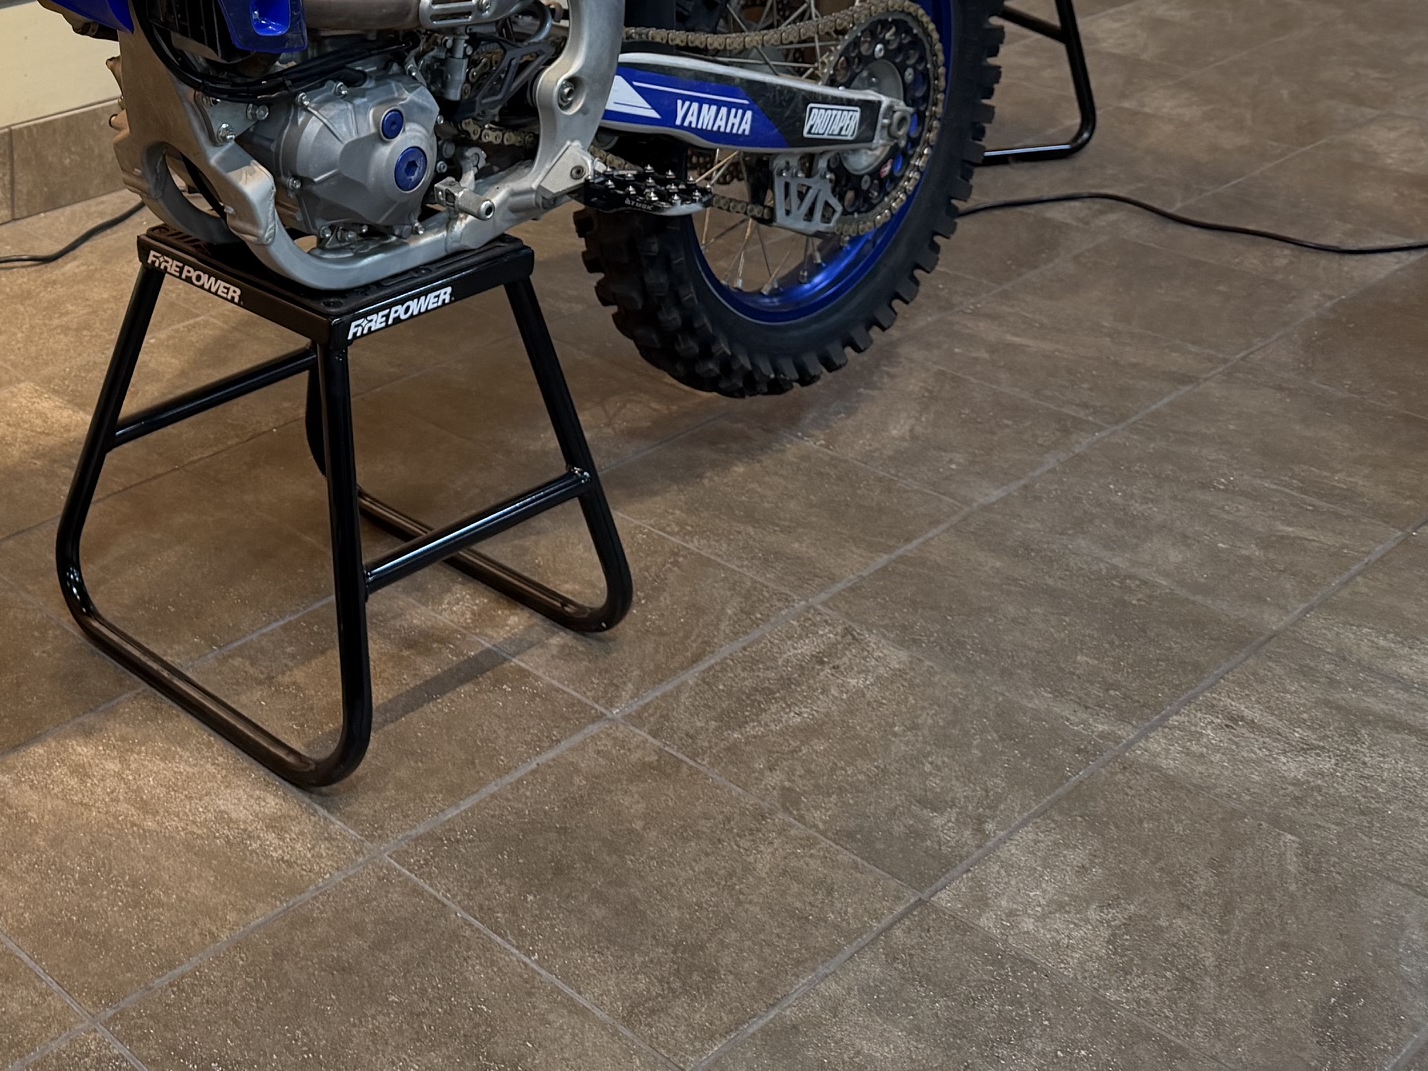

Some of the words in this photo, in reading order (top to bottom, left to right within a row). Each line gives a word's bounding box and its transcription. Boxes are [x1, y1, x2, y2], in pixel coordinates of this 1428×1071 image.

[675, 99, 753, 136] YAMAHA
[806, 107, 860, 137] PROTAPER
[147, 250, 181, 280] FIRE
[180, 264, 242, 304] POWER
[347, 309, 389, 341] FIRE
[387, 286, 453, 327] POWER
